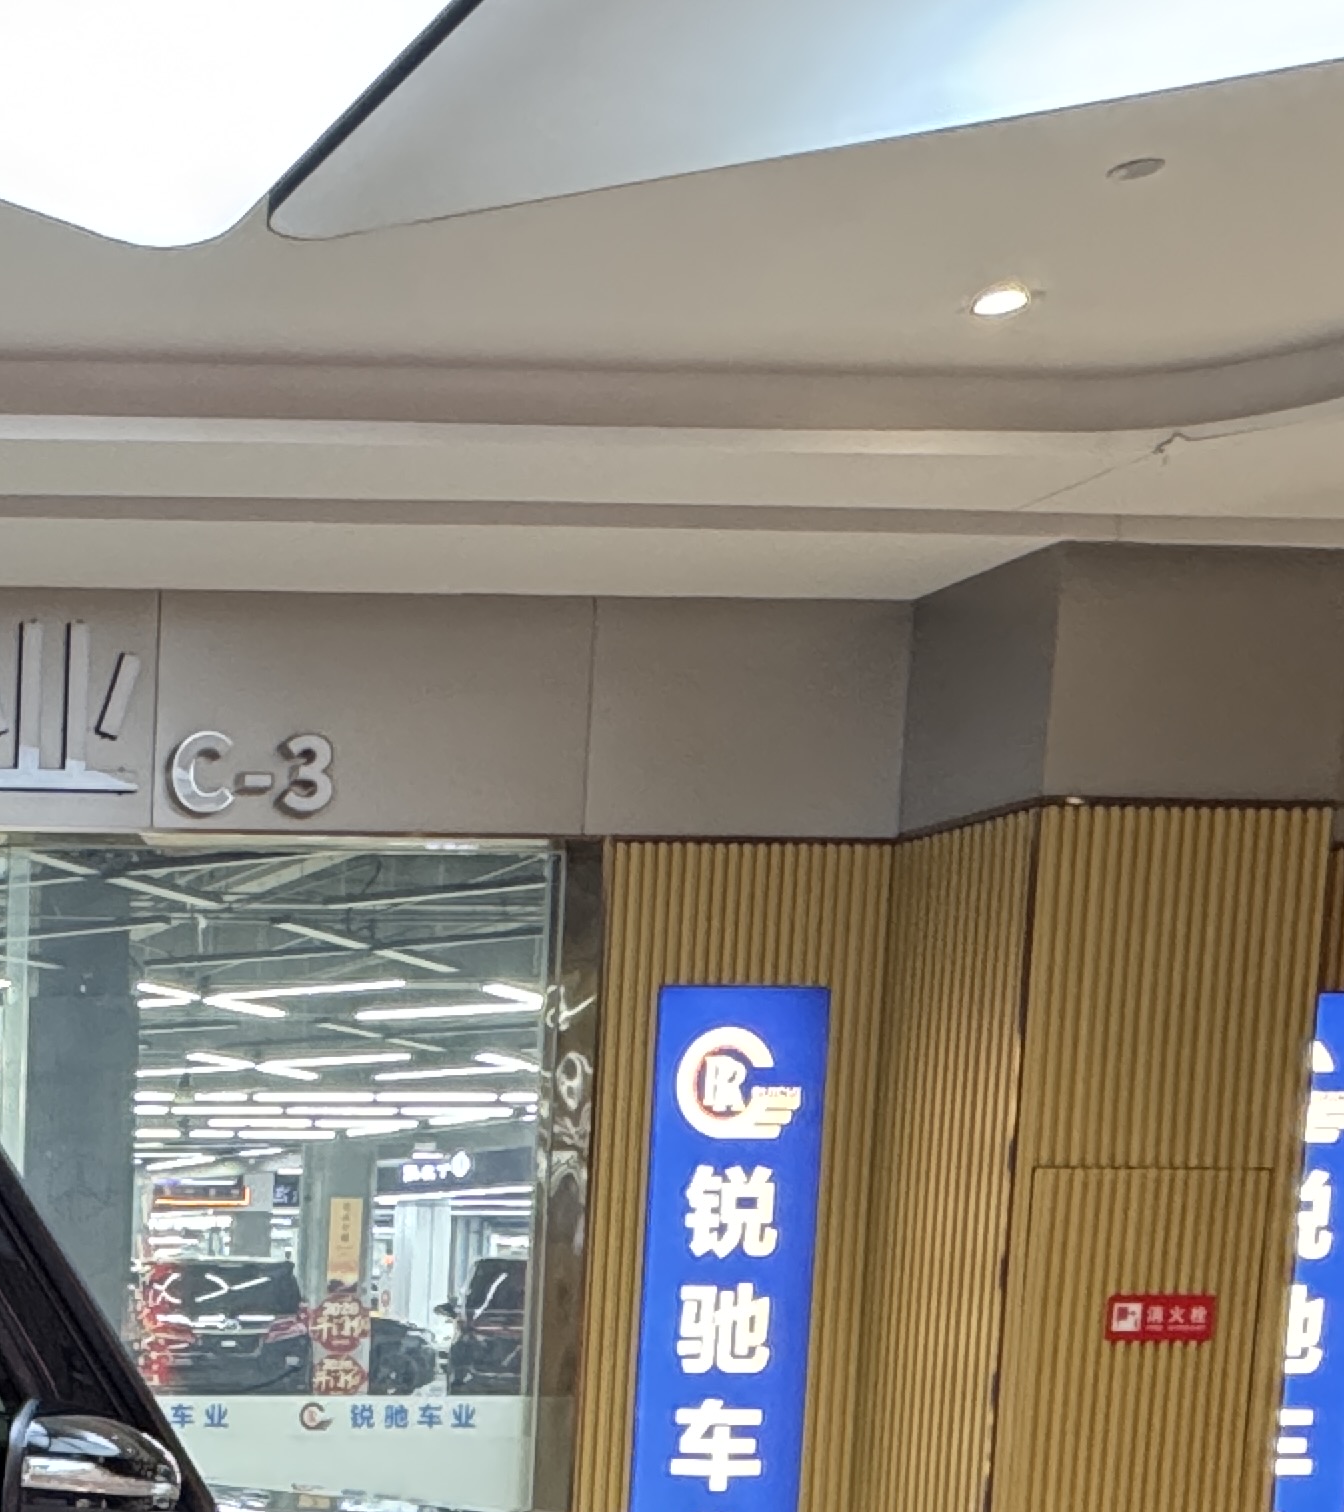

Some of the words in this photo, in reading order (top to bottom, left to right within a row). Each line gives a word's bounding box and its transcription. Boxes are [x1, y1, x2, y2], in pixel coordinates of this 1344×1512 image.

[167, 729, 336, 818] C-3
[350, 1403, 477, 1430] 锐驰车业
